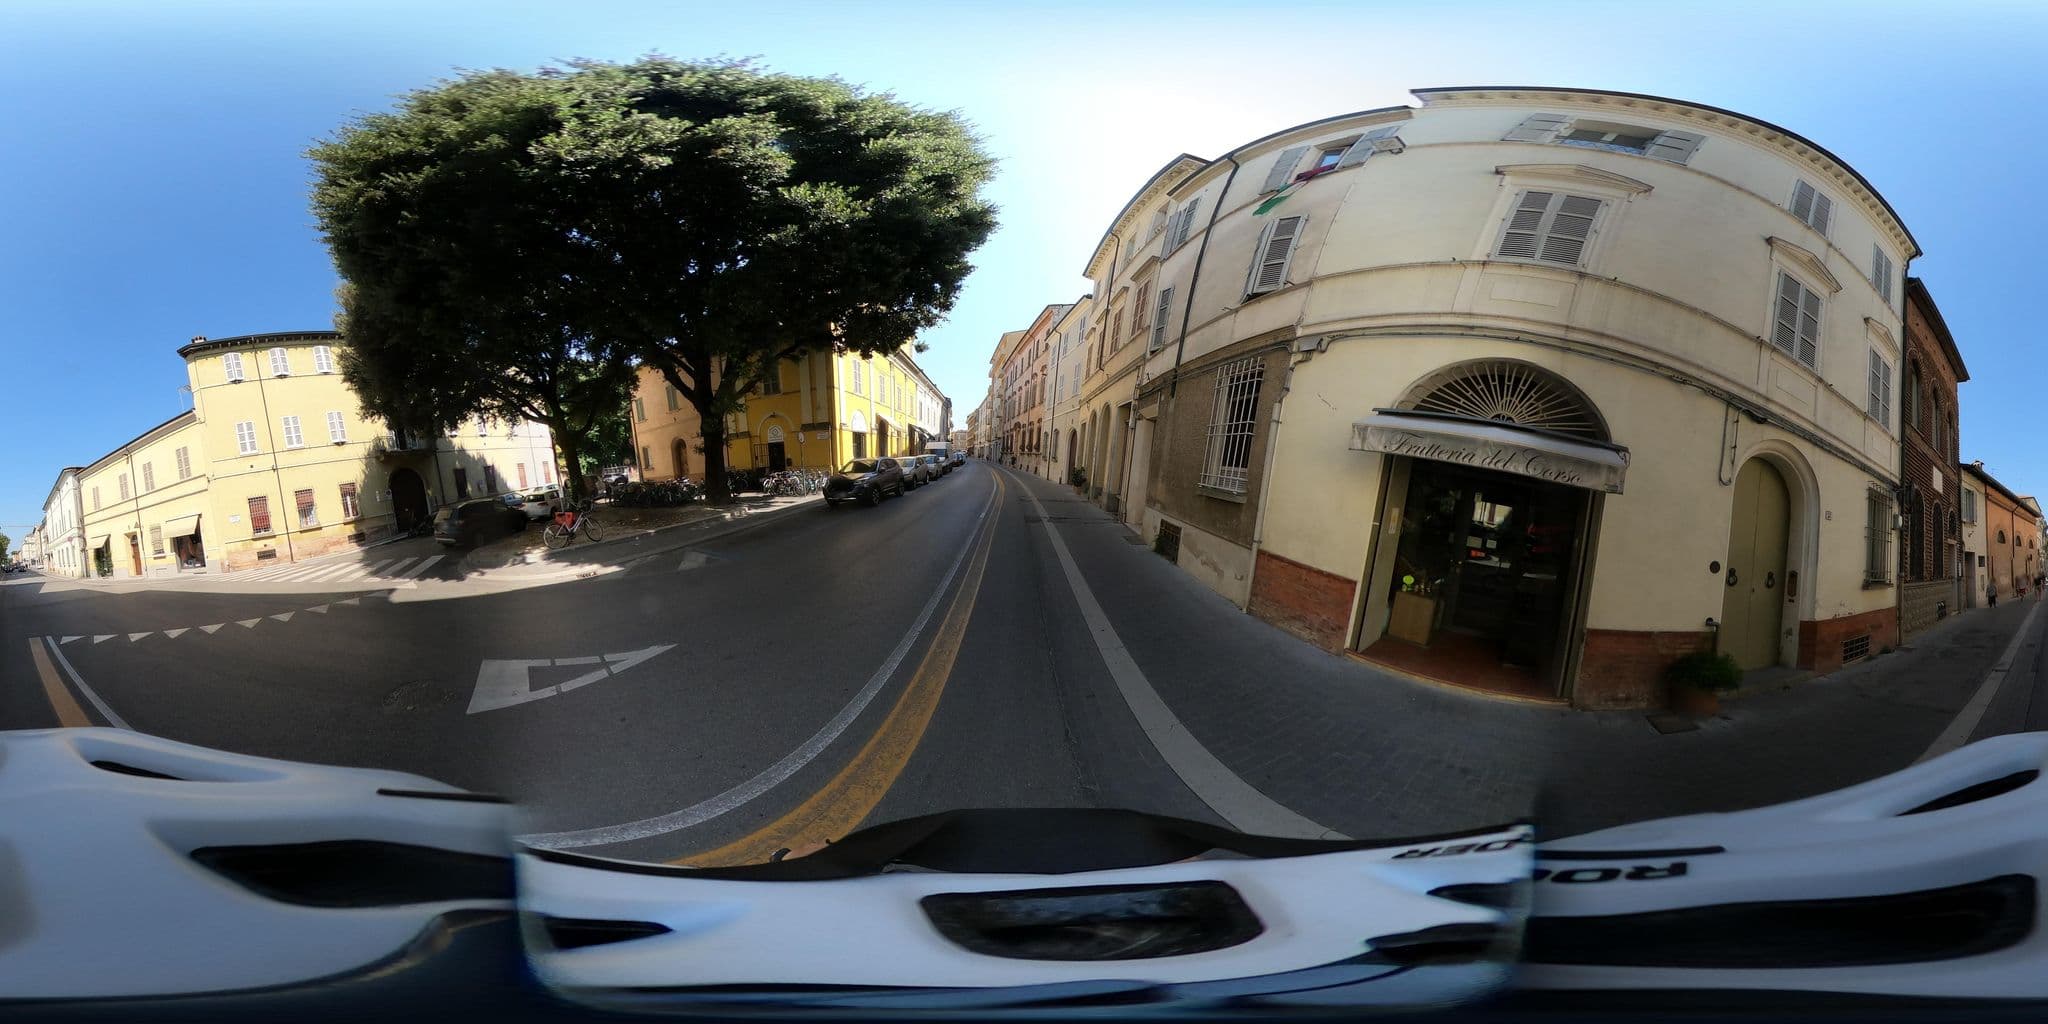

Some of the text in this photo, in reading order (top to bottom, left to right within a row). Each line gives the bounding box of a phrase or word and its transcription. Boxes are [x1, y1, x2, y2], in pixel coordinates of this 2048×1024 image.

[1384, 434, 1582, 484] Frutteria del Corso
